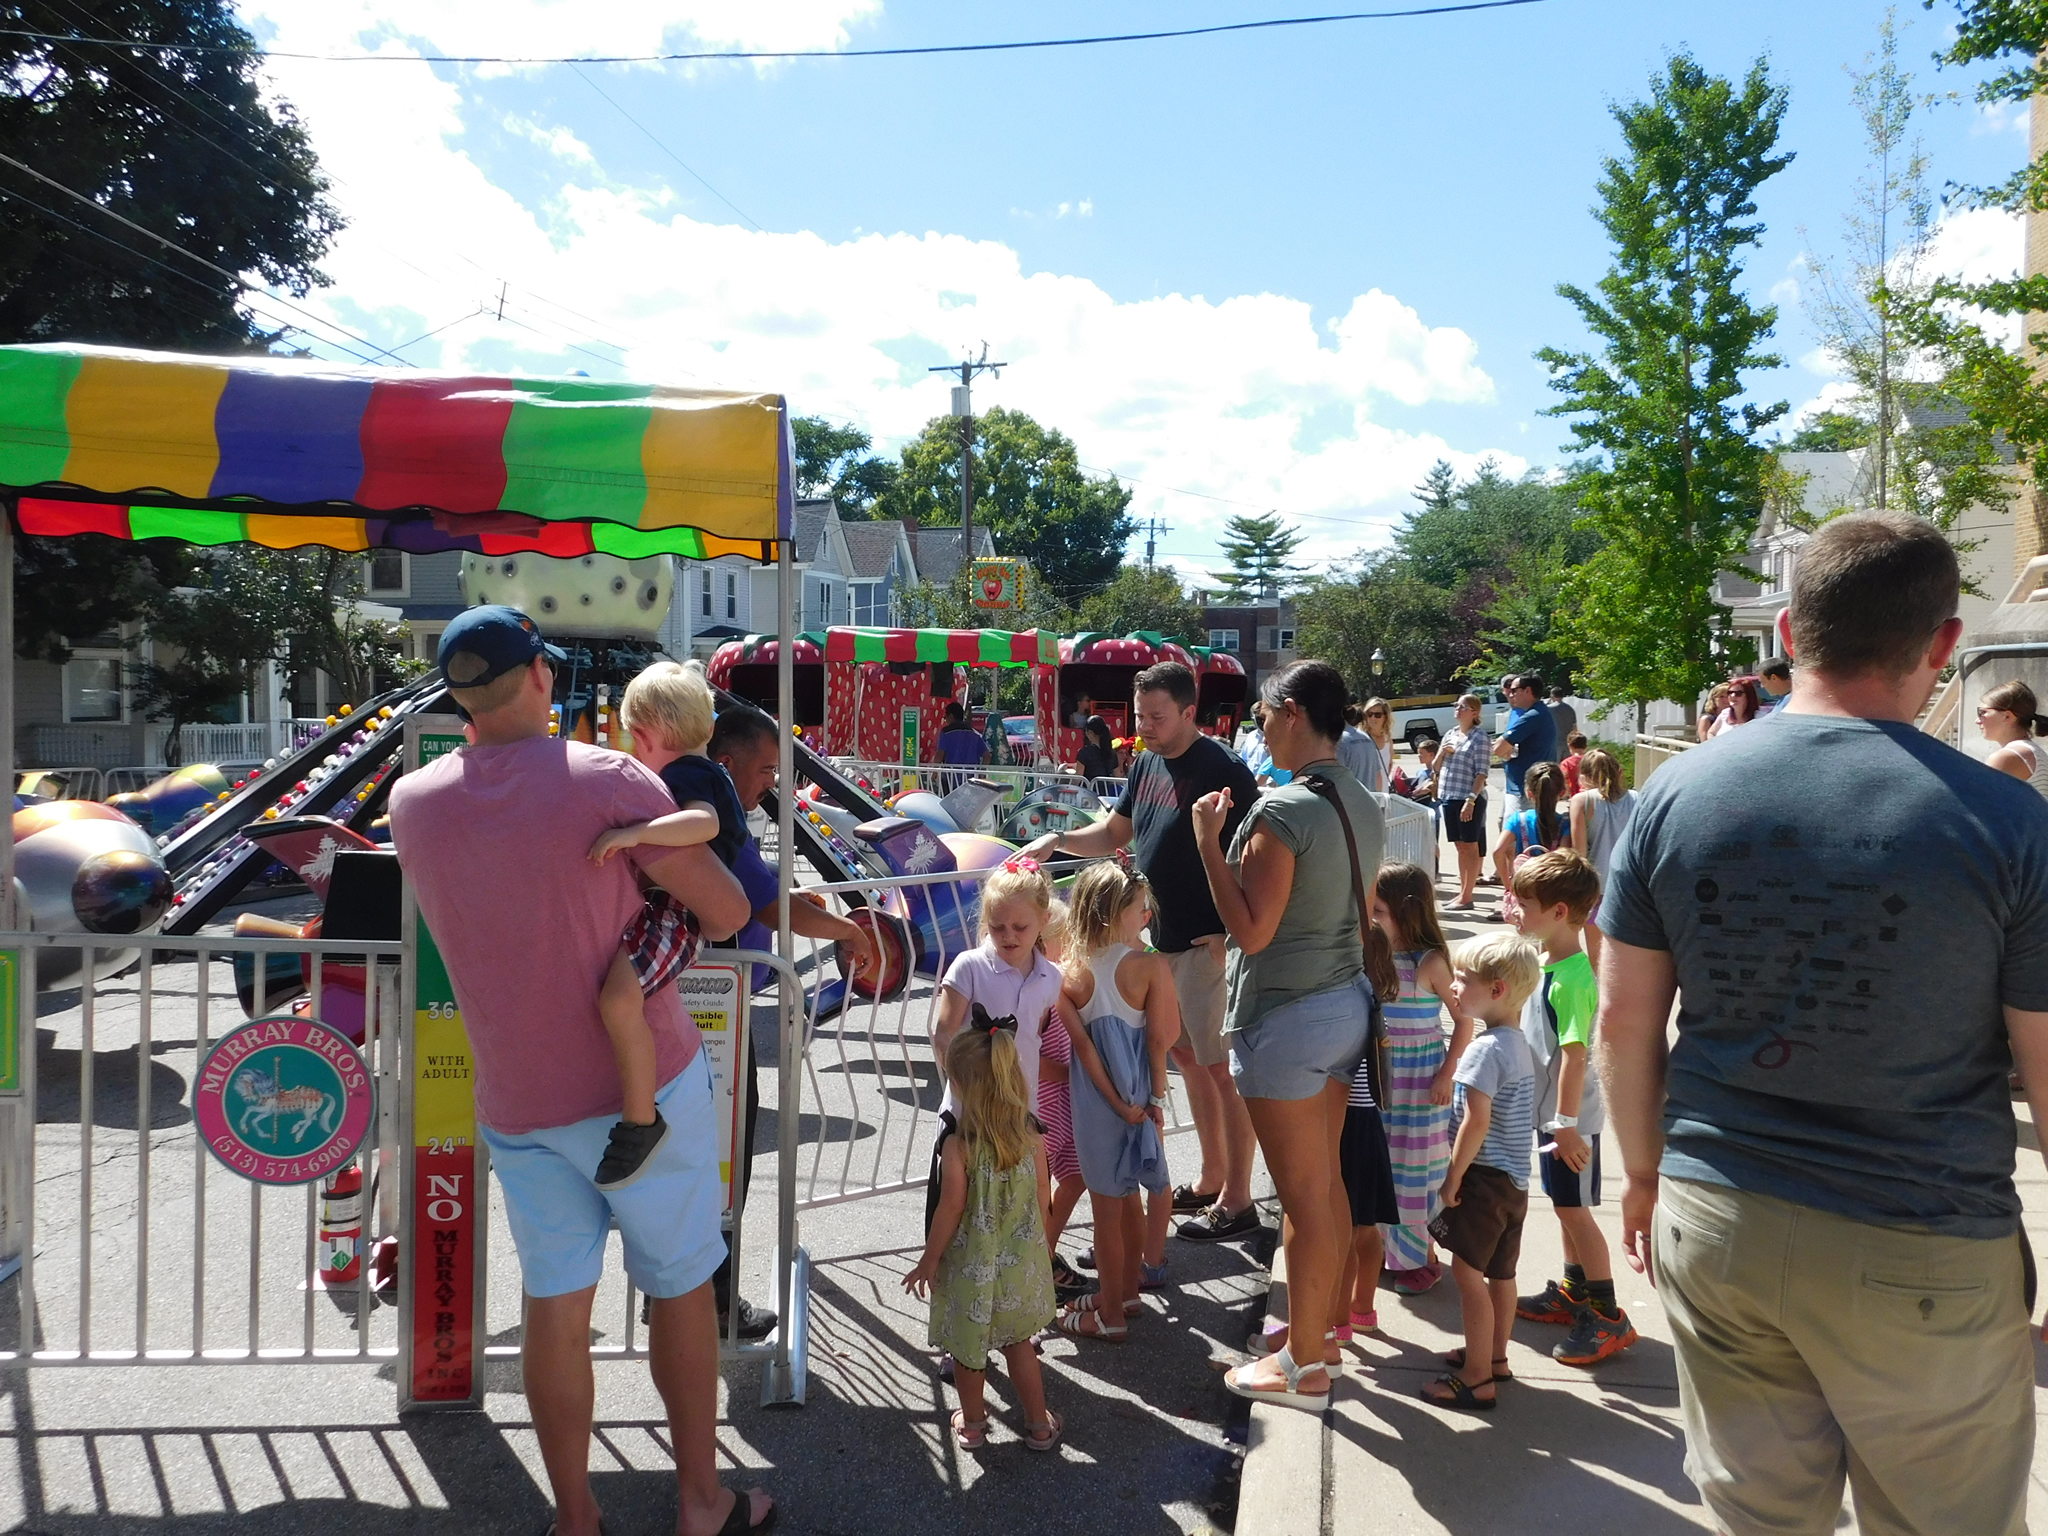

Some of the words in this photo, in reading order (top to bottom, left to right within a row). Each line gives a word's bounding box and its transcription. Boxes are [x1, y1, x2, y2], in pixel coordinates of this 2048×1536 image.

[422, 741, 439, 752] CAN
[440, 741, 457, 752] YOU
[906, 737, 915, 758] YES
[682, 998, 701, 1008] afety
[702, 998, 725, 1008] Guide
[704, 1039, 726, 1047] anges
[202, 1022, 296, 1095] MURRAY
[304, 1027, 365, 1096] BROS.
[427, 1055, 465, 1066] WITH
[422, 1069, 470, 1079] ADULT
[427, 1136, 467, 1156] 24"
[212, 1135, 258, 1174] (513)
[264, 1137, 351, 1178] 574-6900
[426, 1175, 464, 1222] NO
[433, 1230, 458, 1307] MURRAY
[433, 1311, 456, 1364] BROS
